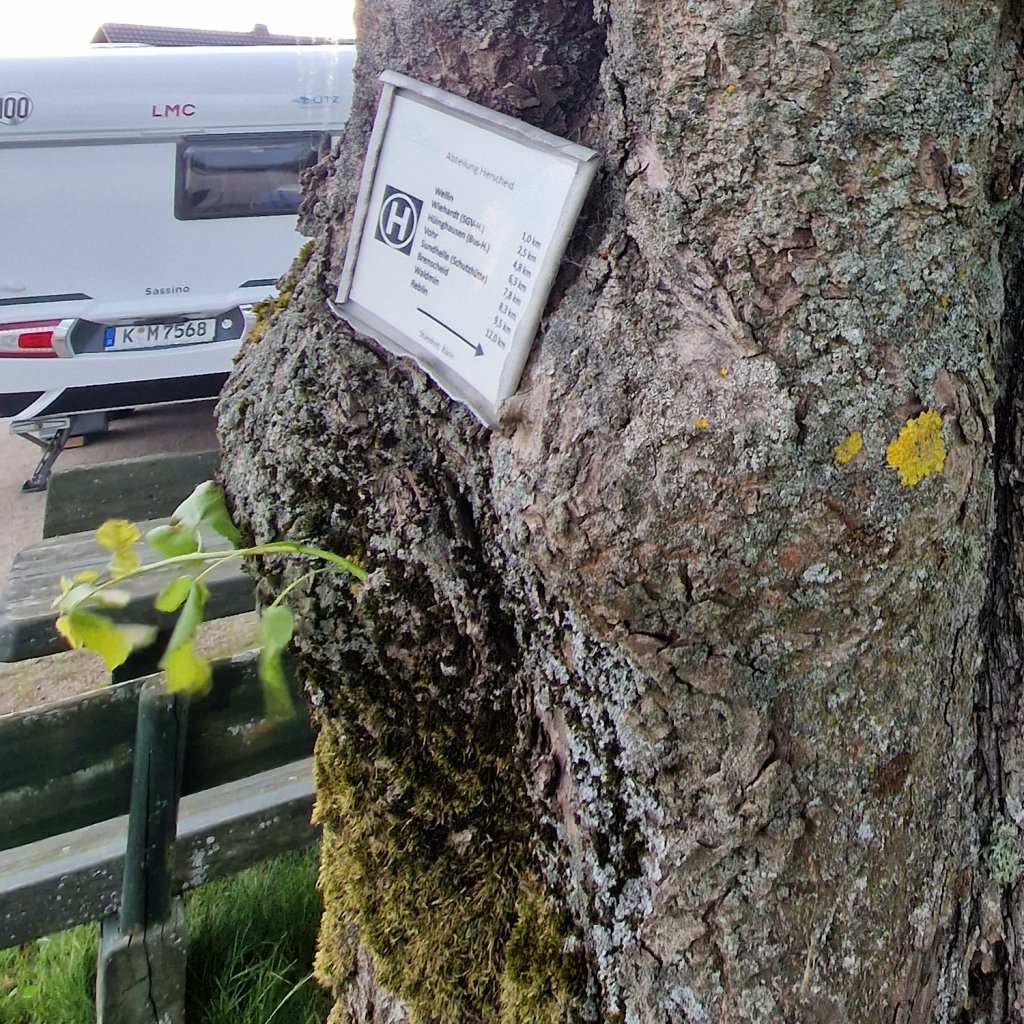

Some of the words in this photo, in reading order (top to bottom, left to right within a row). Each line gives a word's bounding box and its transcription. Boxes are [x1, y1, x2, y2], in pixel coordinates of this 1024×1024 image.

[152, 104, 196, 118] LMC
[386, 200, 412, 241] H
[145, 286, 190, 296] Sassino
